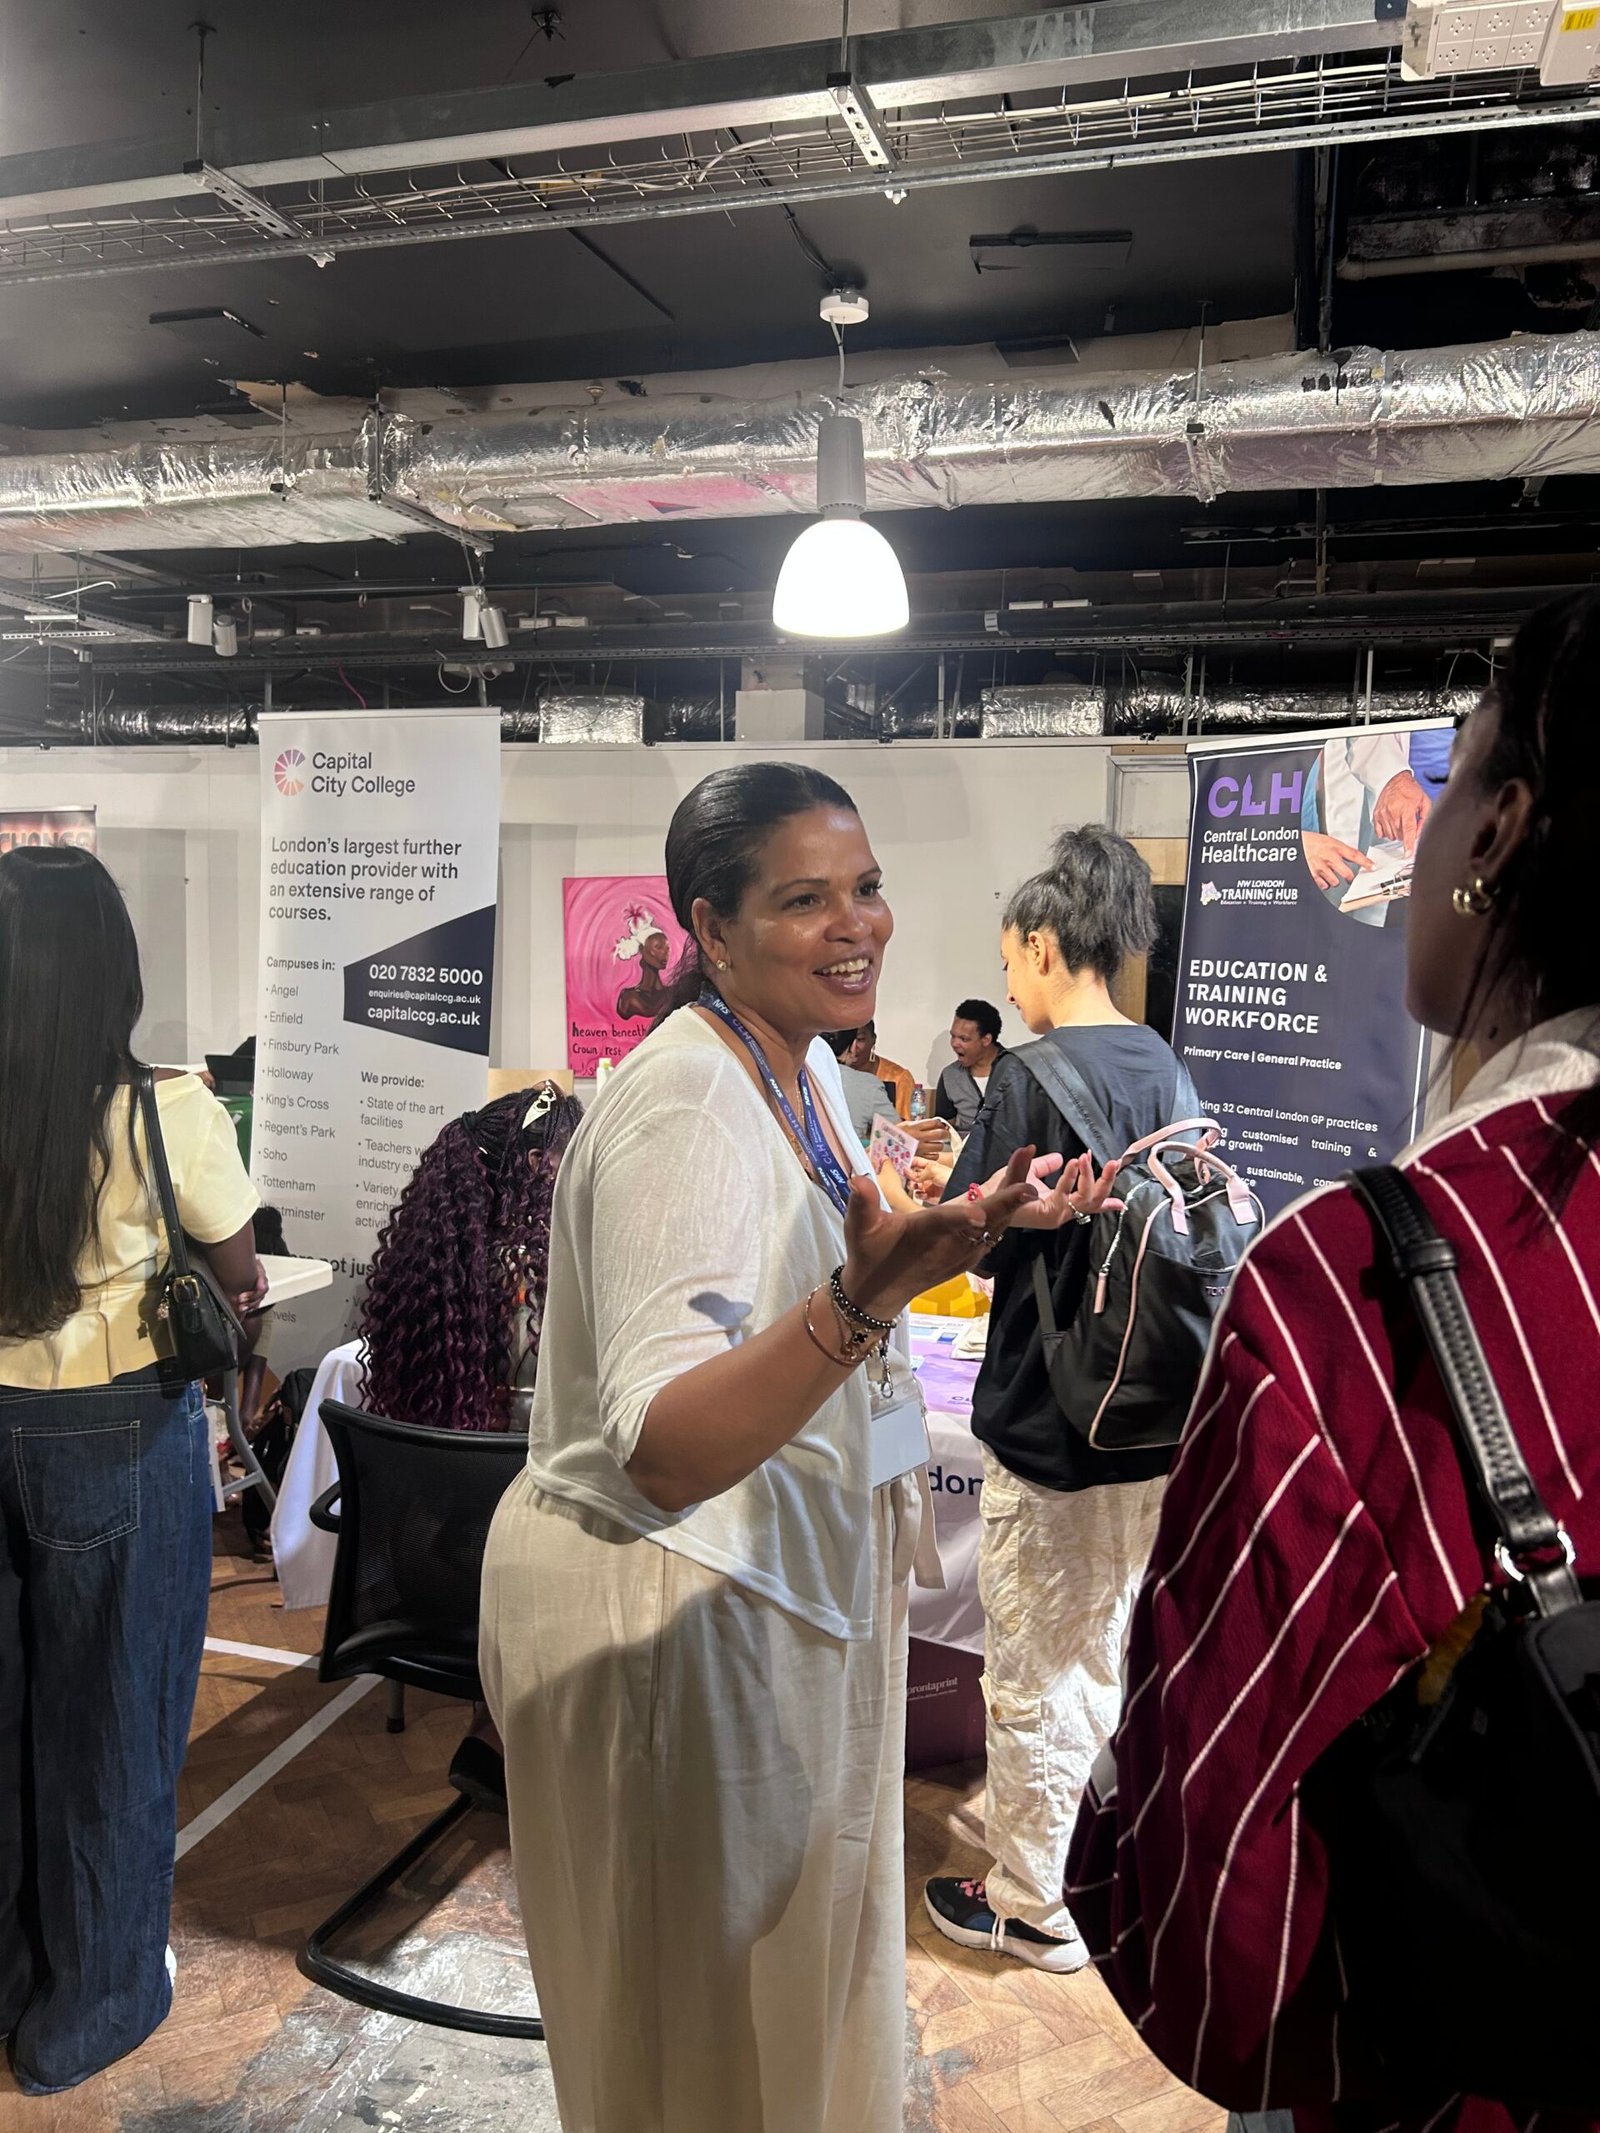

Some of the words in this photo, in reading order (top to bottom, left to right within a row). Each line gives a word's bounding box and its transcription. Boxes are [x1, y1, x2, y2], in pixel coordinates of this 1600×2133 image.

[312, 752, 372, 774] Capital
[311, 776, 347, 797] City
[351, 776, 416, 797] College
[1208, 771, 1303, 818] CLH
[1203, 827, 1247, 843] Central
[1251, 826, 1299, 842] London
[271, 836, 339, 854] London's
[344, 838, 399, 858] largest
[403, 838, 462, 856] further
[1201, 843, 1298, 863] Healthcare
[270, 860, 346, 876] education
[351, 861, 418, 880] provider
[421, 862, 459, 879] with
[269, 884, 285, 897] an
[288, 883, 366, 899] extensive
[369, 887, 414, 904] range
[418, 885, 436, 902] of
[1237, 880, 1250, 888] NW
[1251, 880, 1285, 888] LONDON
[1221, 888, 1273, 900] TRAINING
[1275, 888, 1298, 900] HUB
[268, 906, 332, 921] courses.
[266, 956, 318, 971] Campuses
[321, 958, 336, 971] in:
[1189, 959, 1308, 982] EDUCATION
[1314, 964, 1328, 983] &
[369, 964, 397, 980] 020
[400, 965, 436, 982] 7832
[439, 968, 483, 986] 5000
[271, 984, 299, 999] Angel
[368, 989, 481, 1004] enquiries@capitalccg.ac.uk
[1187, 983, 1287, 1006] TRAINING
[367, 1006, 481, 1026] capitalccg.ac.uk
[713, 998, 731, 1015] NHS
[269, 1011, 303, 1026] Enfield
[1185, 1007, 1319, 1034] WORKFORCE
[572, 1021, 608, 1037] heaven
[268, 1039, 312, 1056] Finsbury
[314, 1043, 339, 1056] Park
[1183, 1046, 1222, 1061] Primary
[1223, 1049, 1250, 1061] Care
[1257, 1052, 1298, 1066] General
[1299, 1056, 1342, 1070] Practice
[266, 1066, 313, 1084] Holloway
[361, 1071, 379, 1084] We
[381, 1075, 425, 1088] provide:
[769, 1078, 784, 1099] NHS
[265, 1093, 295, 1109] King's
[297, 1096, 330, 1110] Cross
[367, 1096, 394, 1110] State
[396, 1100, 408, 1111] of
[409, 1101, 426, 1113] the
[428, 1104, 445, 1115] art
[360, 1113, 404, 1129] facilities
[1200, 1100, 1220, 1114] king
[1222, 1102, 1235, 1113] 32
[1236, 1105, 1273, 1118] Central
[1275, 1109, 1309, 1123] London
[1311, 1115, 1325, 1126] GP
[1326, 1117, 1379, 1132] practices
[264, 1120, 308, 1137] Regent's
[310, 1125, 336, 1140] Park
[365, 1138, 412, 1155] Teachers
[1228, 1140, 1263, 1152] growth
[1242, 1130, 1299, 1146] customised
[1311, 1138, 1352, 1157] training
[1368, 1147, 1378, 1158] &
[262, 1147, 288, 1162] Soho
[358, 1154, 401, 1173] industry
[816, 1143, 832, 1165] CLH
[262, 1174, 316, 1192] Tottenham
[829, 1168, 846, 1184] NHS
[1246, 1166, 1305, 1185] sustainable,
[363, 1181, 399, 1199] Variety
[350, 1258, 374, 1278] jus
